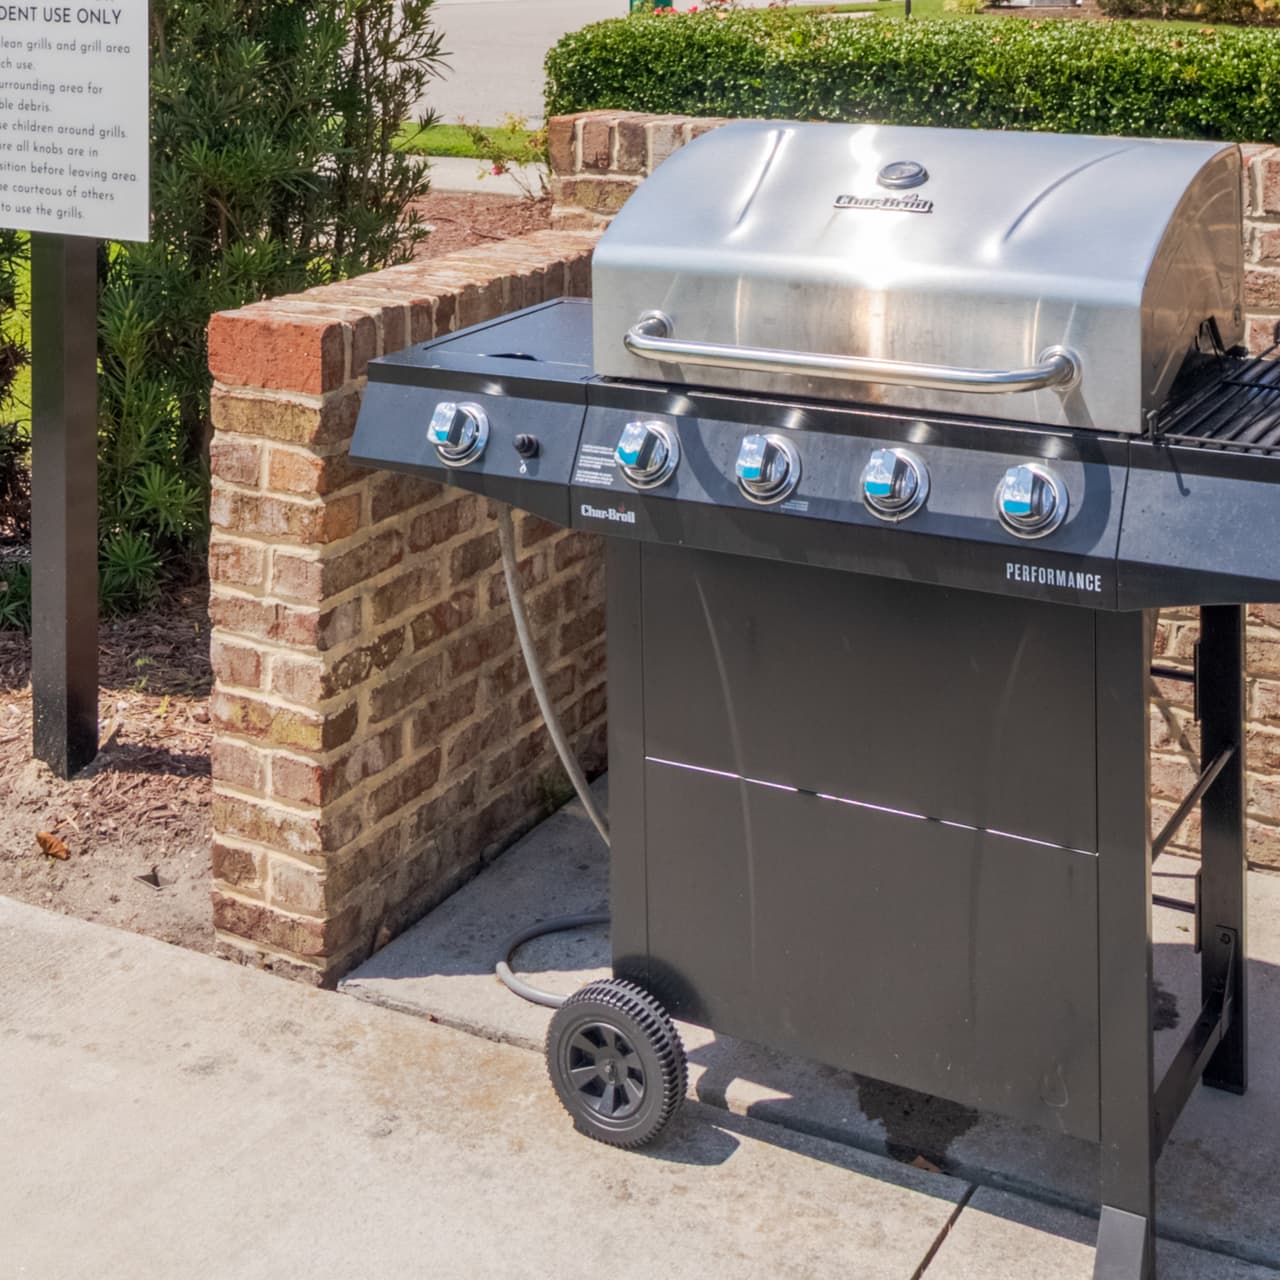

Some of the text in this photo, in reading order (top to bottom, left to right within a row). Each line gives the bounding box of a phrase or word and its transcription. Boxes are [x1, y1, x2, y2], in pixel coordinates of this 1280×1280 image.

[43, 8, 71, 23] USE
[76, 9, 122, 25] ONLY
[26, 37, 52, 52] grills
[56, 38, 76, 51] and
[80, 39, 102, 54] grill
[105, 44, 131, 53] area
[59, 84, 84, 94] area
[87, 81, 103, 94] for
[11, 119, 54, 133] children
[57, 124, 95, 136] around
[16, 140, 30, 152] all
[33, 141, 64, 156] knobs
[67, 147, 85, 156] are
[89, 147, 99, 157] in
[30, 161, 65, 176] before
[68, 164, 108, 182] leaving
[12, 184, 63, 197] courteous
[66, 186, 77, 198] of
[81, 187, 115, 201] others
[1, 202, 12, 212] to
[15, 205, 32, 214] use
[36, 203, 53, 216] the
[835, 194, 932, 211] Char-Broil
[581, 504, 636, 524] Char-Broil
[1006, 563, 1102, 592] PERFORMANCE
